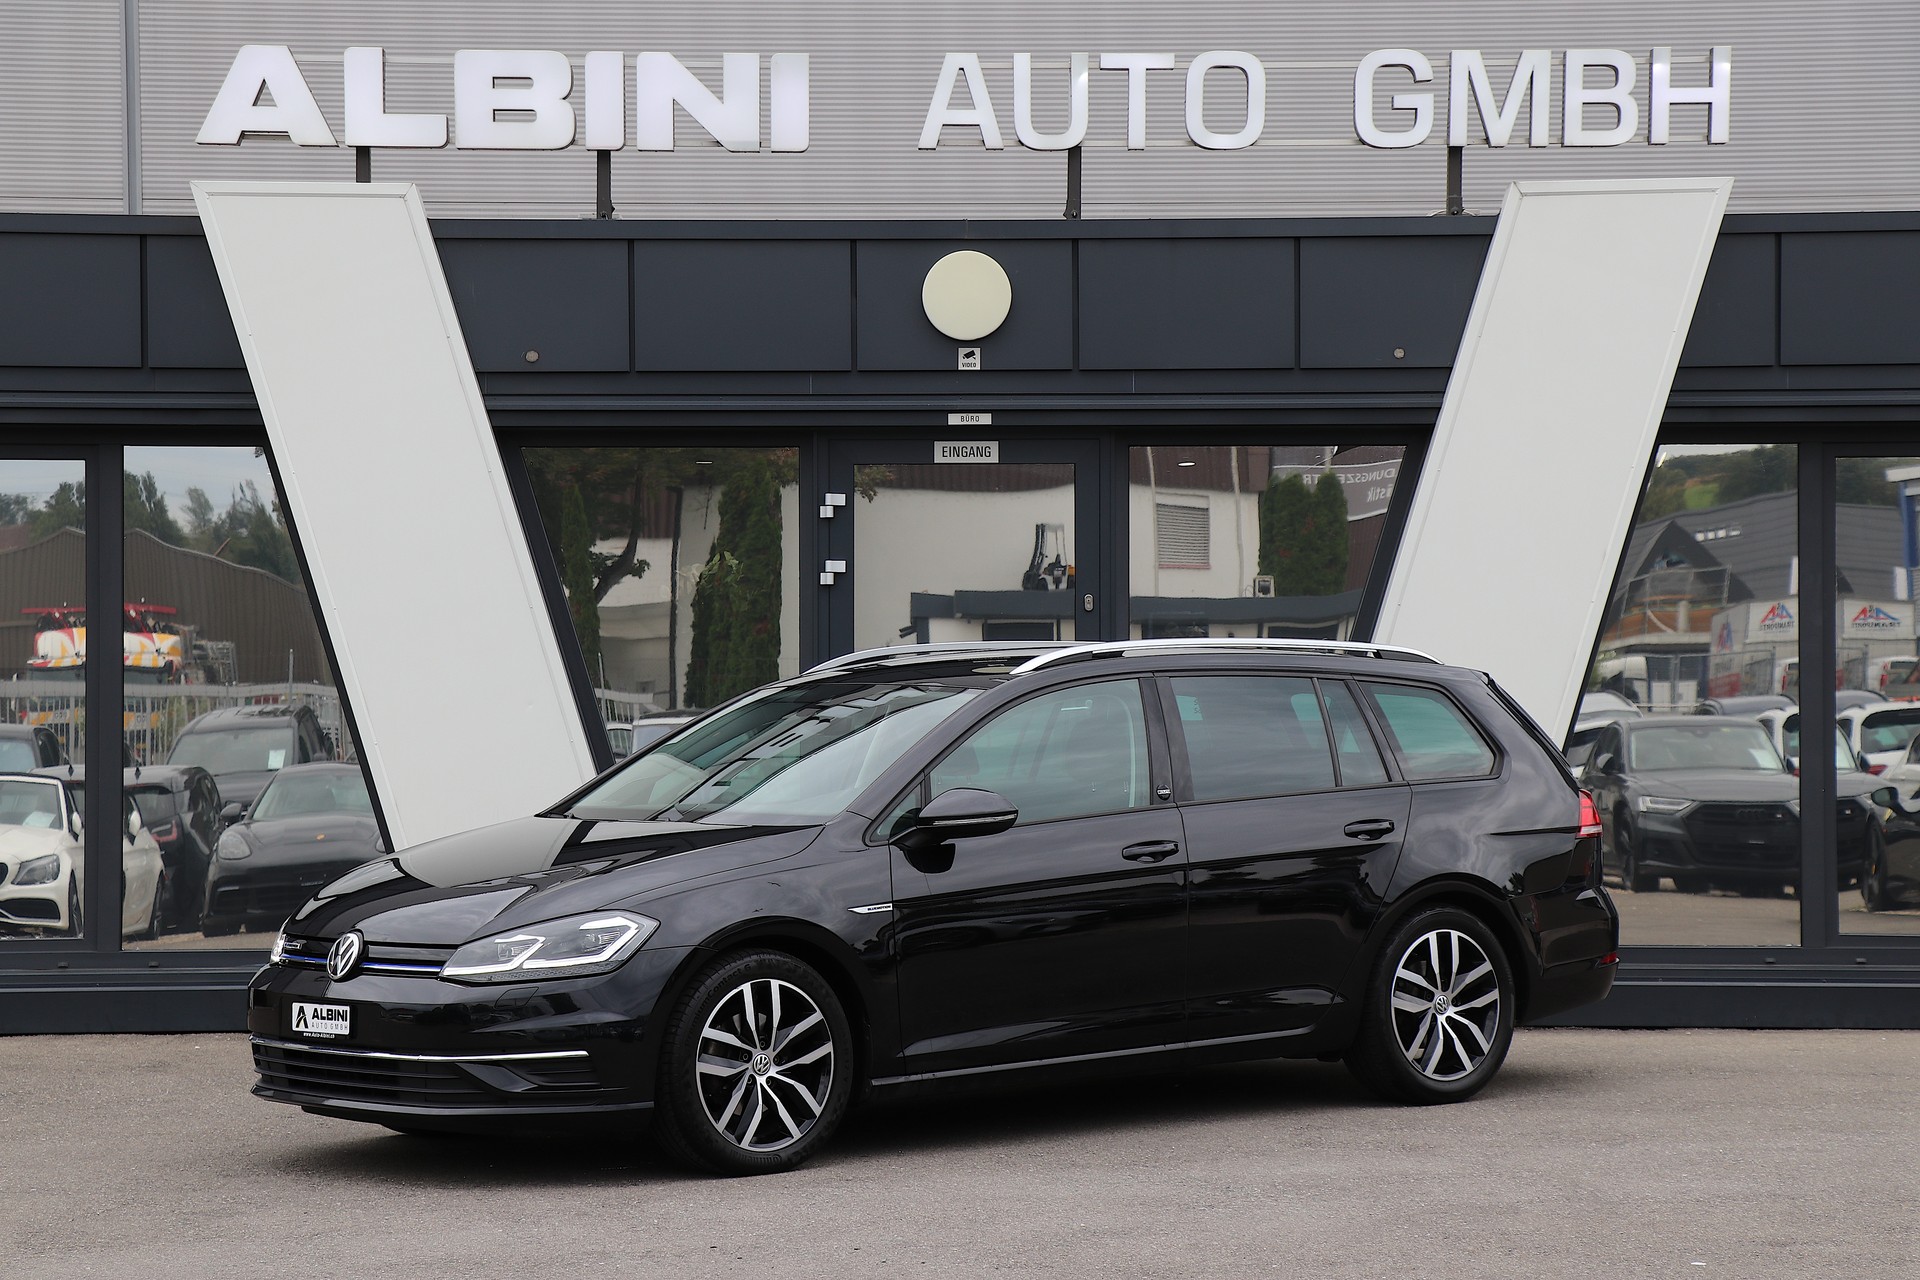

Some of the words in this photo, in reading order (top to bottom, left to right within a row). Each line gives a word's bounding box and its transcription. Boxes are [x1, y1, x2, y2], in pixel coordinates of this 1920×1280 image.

[195, 44, 810, 153] ALBINI
[918, 49, 1266, 152] AUTO
[1354, 46, 1732, 149] GMBH
[960, 415, 980, 423] BÜRO
[942, 445, 992, 458] EINGANG
[311, 1007, 348, 1022] ALBINI
[311, 1021, 328, 1030] AUTO
[330, 1023, 348, 1031] GMBH
